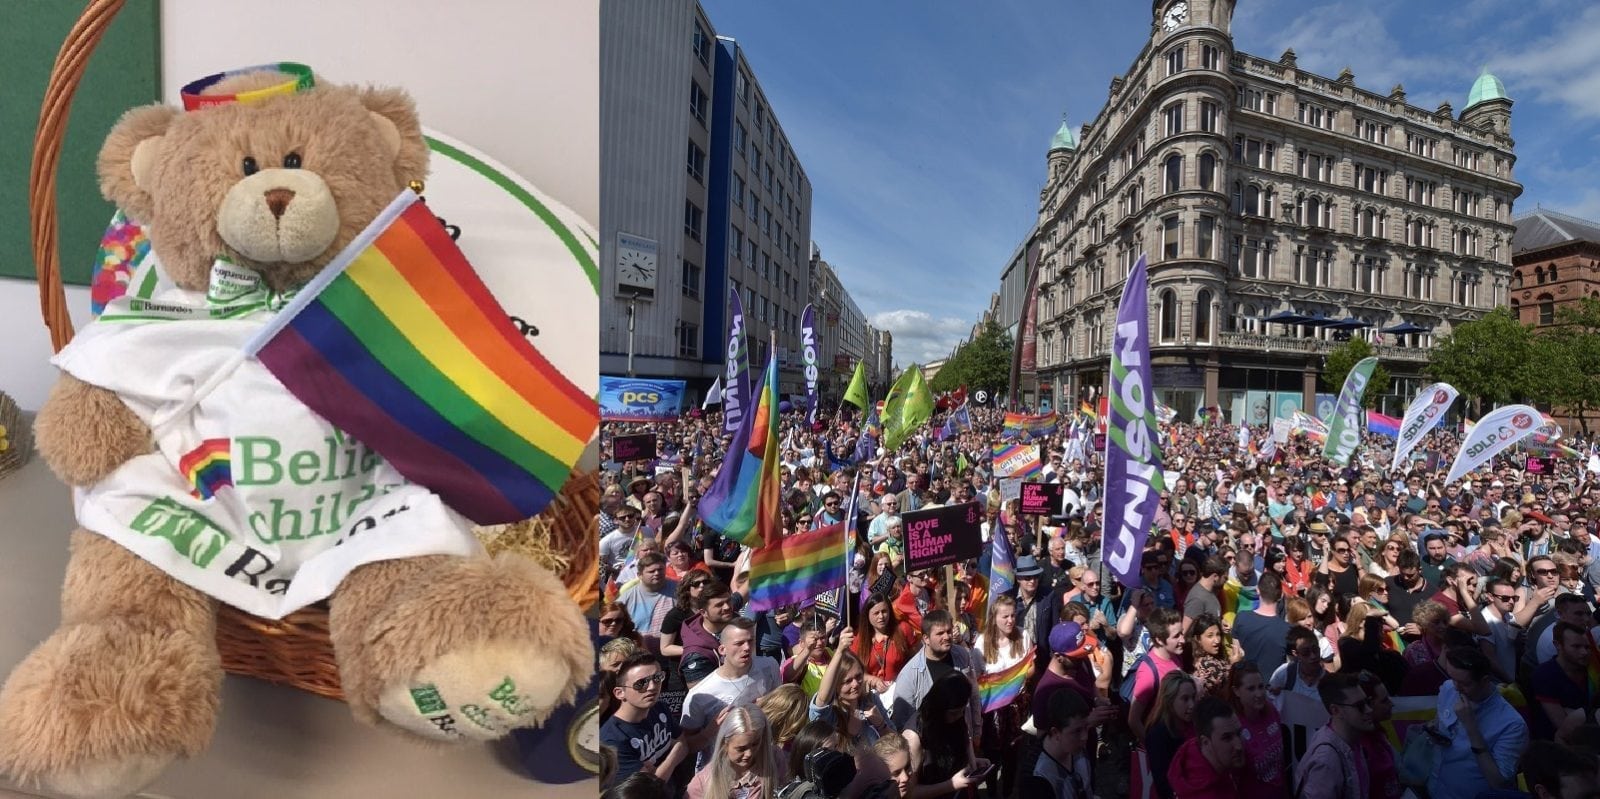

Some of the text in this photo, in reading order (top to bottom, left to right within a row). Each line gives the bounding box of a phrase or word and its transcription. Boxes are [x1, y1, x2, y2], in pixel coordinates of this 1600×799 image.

[802, 327, 819, 425] ISON
[622, 391, 660, 406] pcs
[1403, 414, 1426, 442] SDLP
[1108, 320, 1156, 575] UNISON
[1466, 433, 1498, 458] SDLP
[1024, 484, 1043, 492] LOVE
[908, 518, 939, 533] LOVE
[908, 529, 932, 541] IS A
[909, 533, 953, 551] HUMAN
[909, 543, 945, 560] RIGHT
